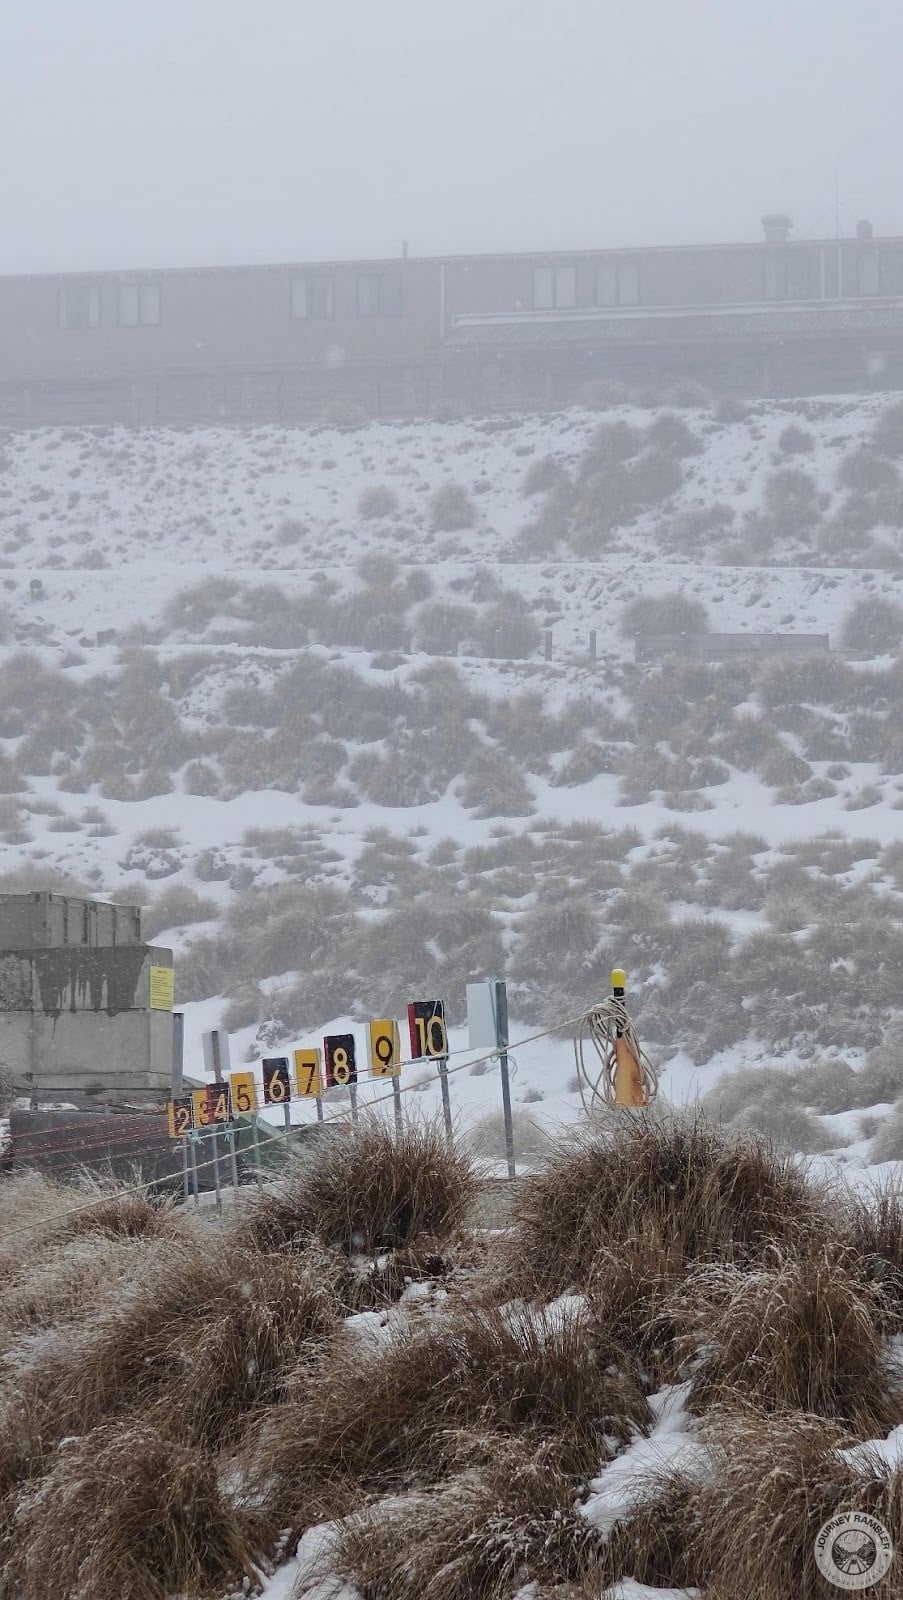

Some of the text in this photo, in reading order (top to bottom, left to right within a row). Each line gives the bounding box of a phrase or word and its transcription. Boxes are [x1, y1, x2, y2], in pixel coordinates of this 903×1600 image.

[415, 1016, 447, 1056] 10
[333, 1047, 350, 1084] 8
[376, 1036, 392, 1073] 9
[269, 1069, 285, 1101] 6
[302, 1063, 316, 1094] 7
[214, 1093, 227, 1121] 4
[237, 1084, 250, 1111] 5
[177, 1108, 190, 1132] 2
[200, 1102, 209, 1125] 3
